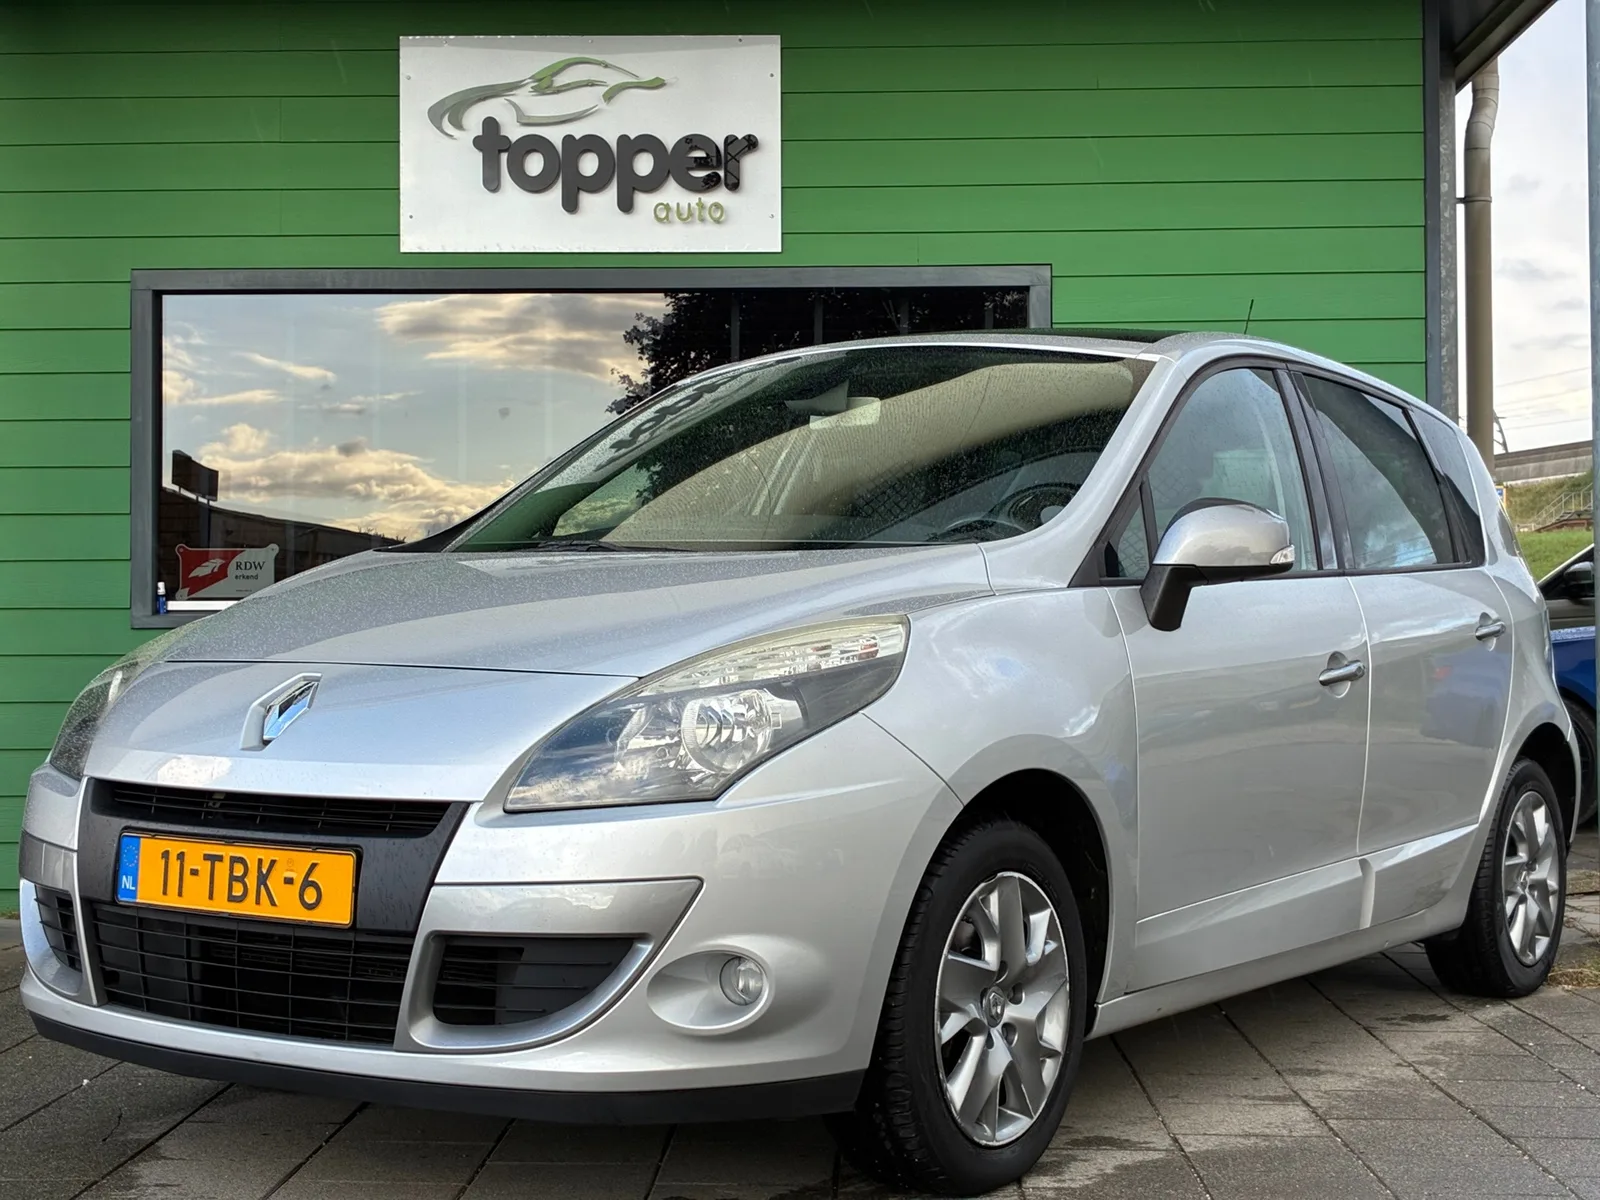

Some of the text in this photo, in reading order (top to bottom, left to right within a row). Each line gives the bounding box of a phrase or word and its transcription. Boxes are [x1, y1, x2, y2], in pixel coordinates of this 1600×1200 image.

[472, 116, 759, 213] topper
[653, 197, 725, 223] auto
[235, 561, 265, 570] RDW
[121, 875, 136, 890] NL
[161, 849, 323, 911] 11-TBK-6
